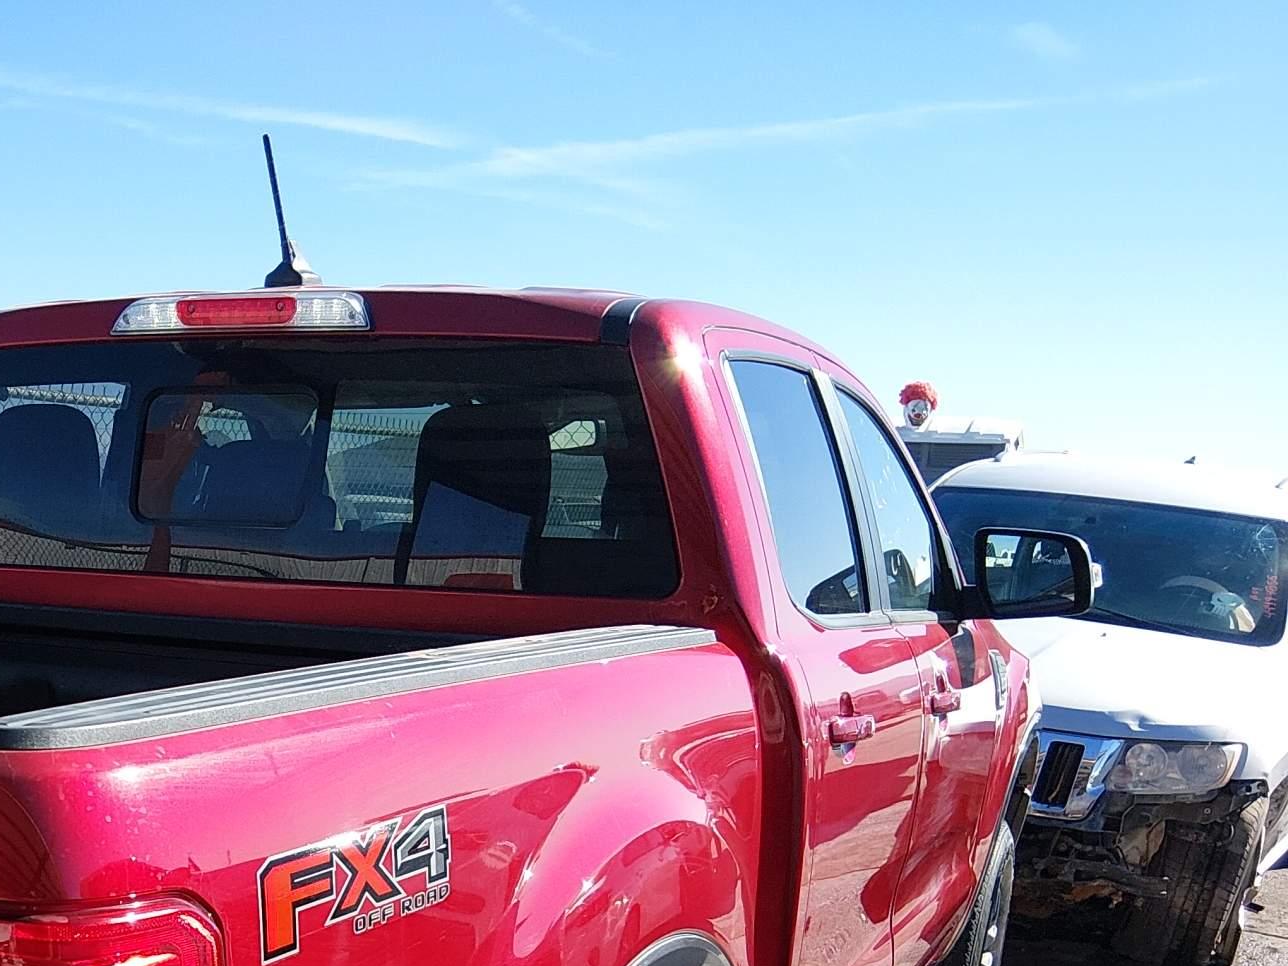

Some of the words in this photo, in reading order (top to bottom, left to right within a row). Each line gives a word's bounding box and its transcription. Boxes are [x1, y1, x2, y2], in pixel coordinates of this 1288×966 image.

[257, 803, 451, 966] FX4
[353, 906, 395, 935] OFF
[399, 883, 450, 917] ROAD
